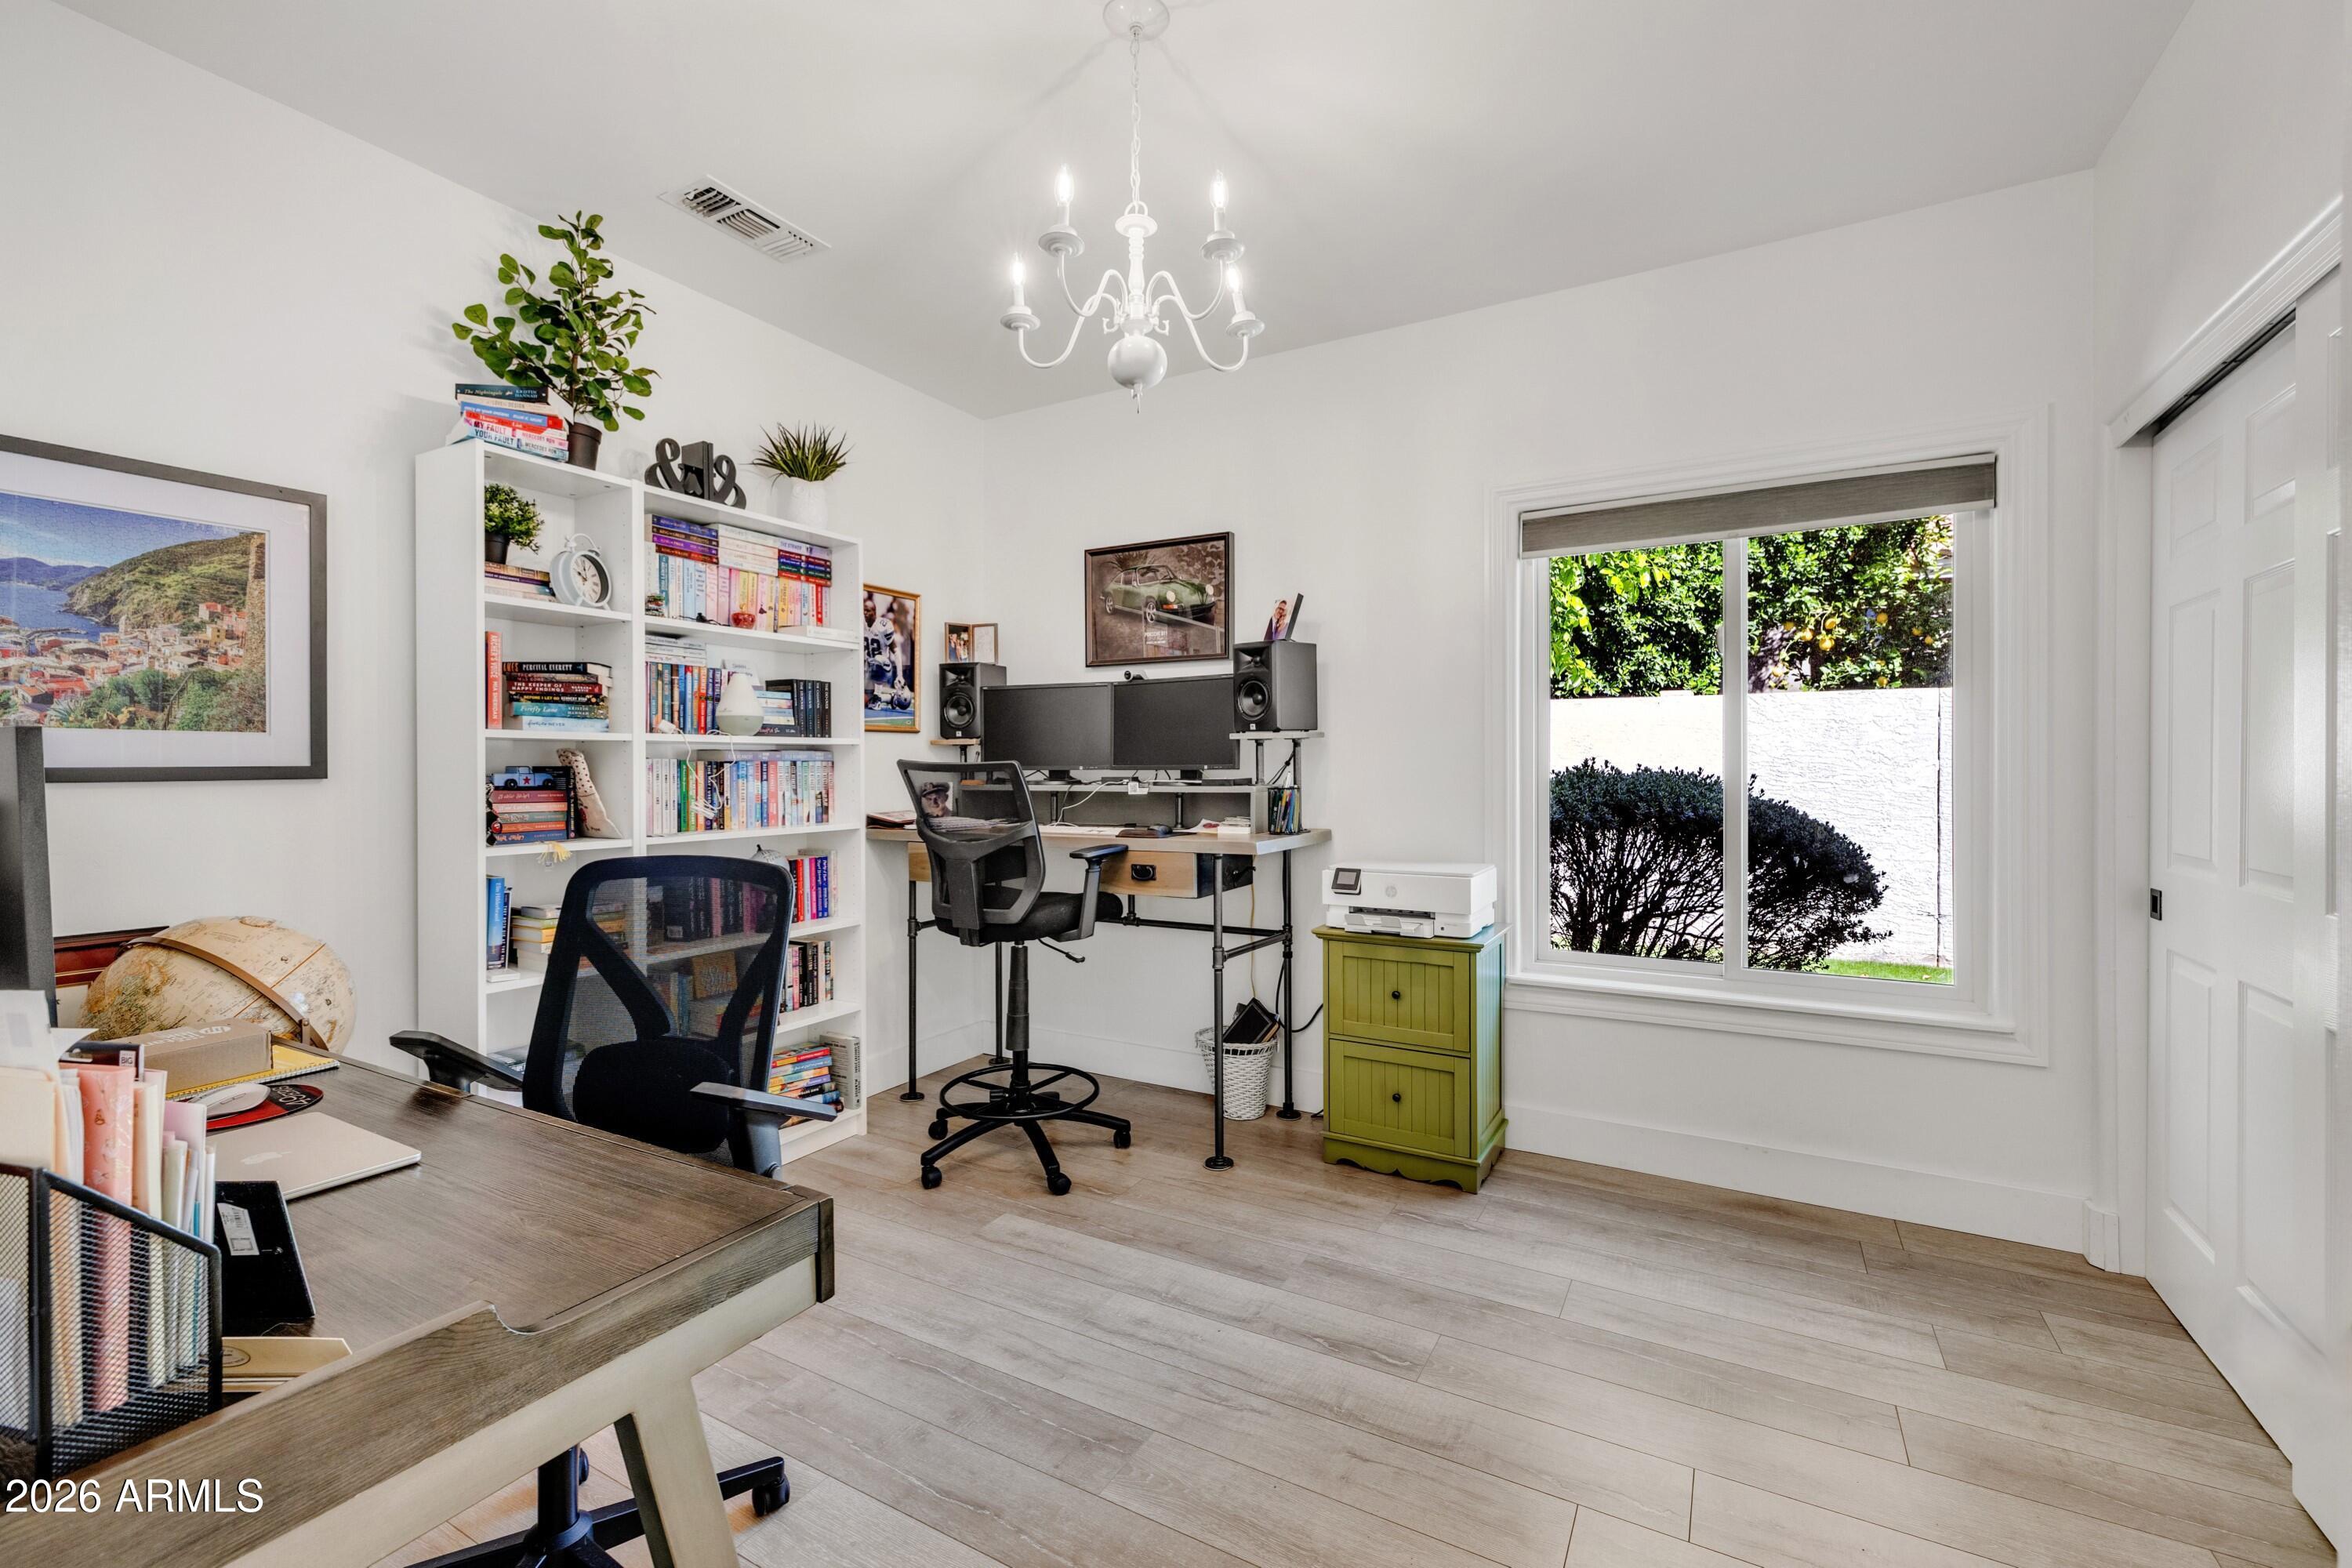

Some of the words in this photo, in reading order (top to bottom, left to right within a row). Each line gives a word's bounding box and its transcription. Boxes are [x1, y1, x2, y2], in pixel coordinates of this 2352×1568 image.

[474, 421, 485, 430] MY
[485, 423, 507, 435] FAULT
[474, 428, 493, 439] YOUR
[494, 435, 514, 446] FAULT
[490, 662, 499, 678] VOICE
[549, 663, 572, 672] EVERETT
[121, 1056, 133, 1065] BIG
[271, 1085, 312, 1105] 49ERS
